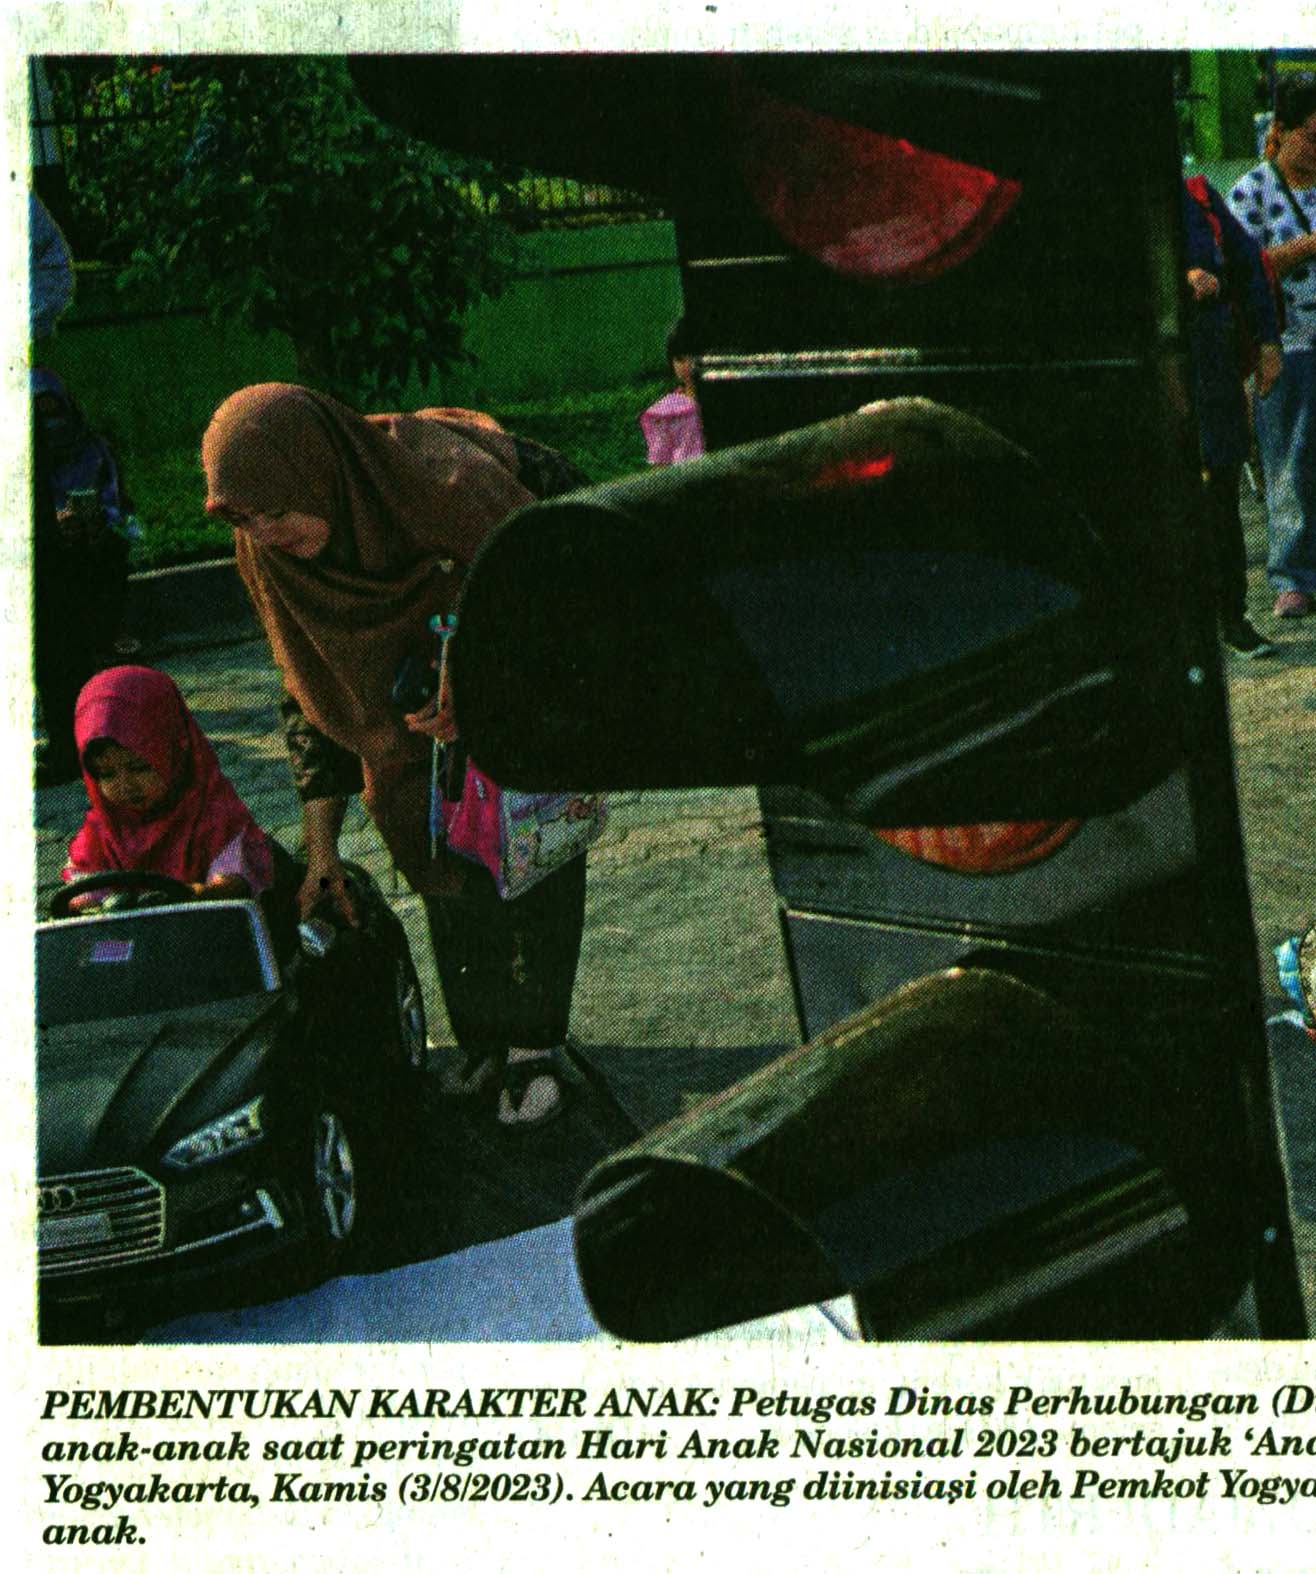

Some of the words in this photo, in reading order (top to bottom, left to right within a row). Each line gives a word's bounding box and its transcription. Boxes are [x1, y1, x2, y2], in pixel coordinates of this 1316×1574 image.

[41, 1390, 360, 1419] PEMBENTUKAN
[367, 1389, 586, 1418] KARAKTER
[595, 1388, 719, 1417] ANAK:
[729, 1388, 875, 1423] Petugas
[886, 1387, 994, 1416] Dinas
[1005, 1386, 1258, 1421] Perhubungan
[42, 1432, 249, 1461] anak-anak
[263, 1434, 344, 1460] saat
[351, 1432, 565, 1467] peringatan
[578, 1430, 667, 1459] Hari
[678, 1430, 779, 1458] Anak
[791, 1429, 964, 1458] Nasional
[974, 1430, 1058, 1457] 2023
[1071, 1427, 1230, 1463] bertajuk
[43, 1474, 259, 1510] Yogyakarta,
[270, 1474, 386, 1502] Kamis
[399, 1473, 572, 1503] (3/8/2023).
[583, 1473, 696, 1500] Acara
[704, 1479, 795, 1507] yang
[804, 1471, 976, 1501] diinisiasi
[987, 1470, 1061, 1499] oleh
[1071, 1470, 1209, 1498] Pemkot
[43, 1516, 145, 1544] anak.
